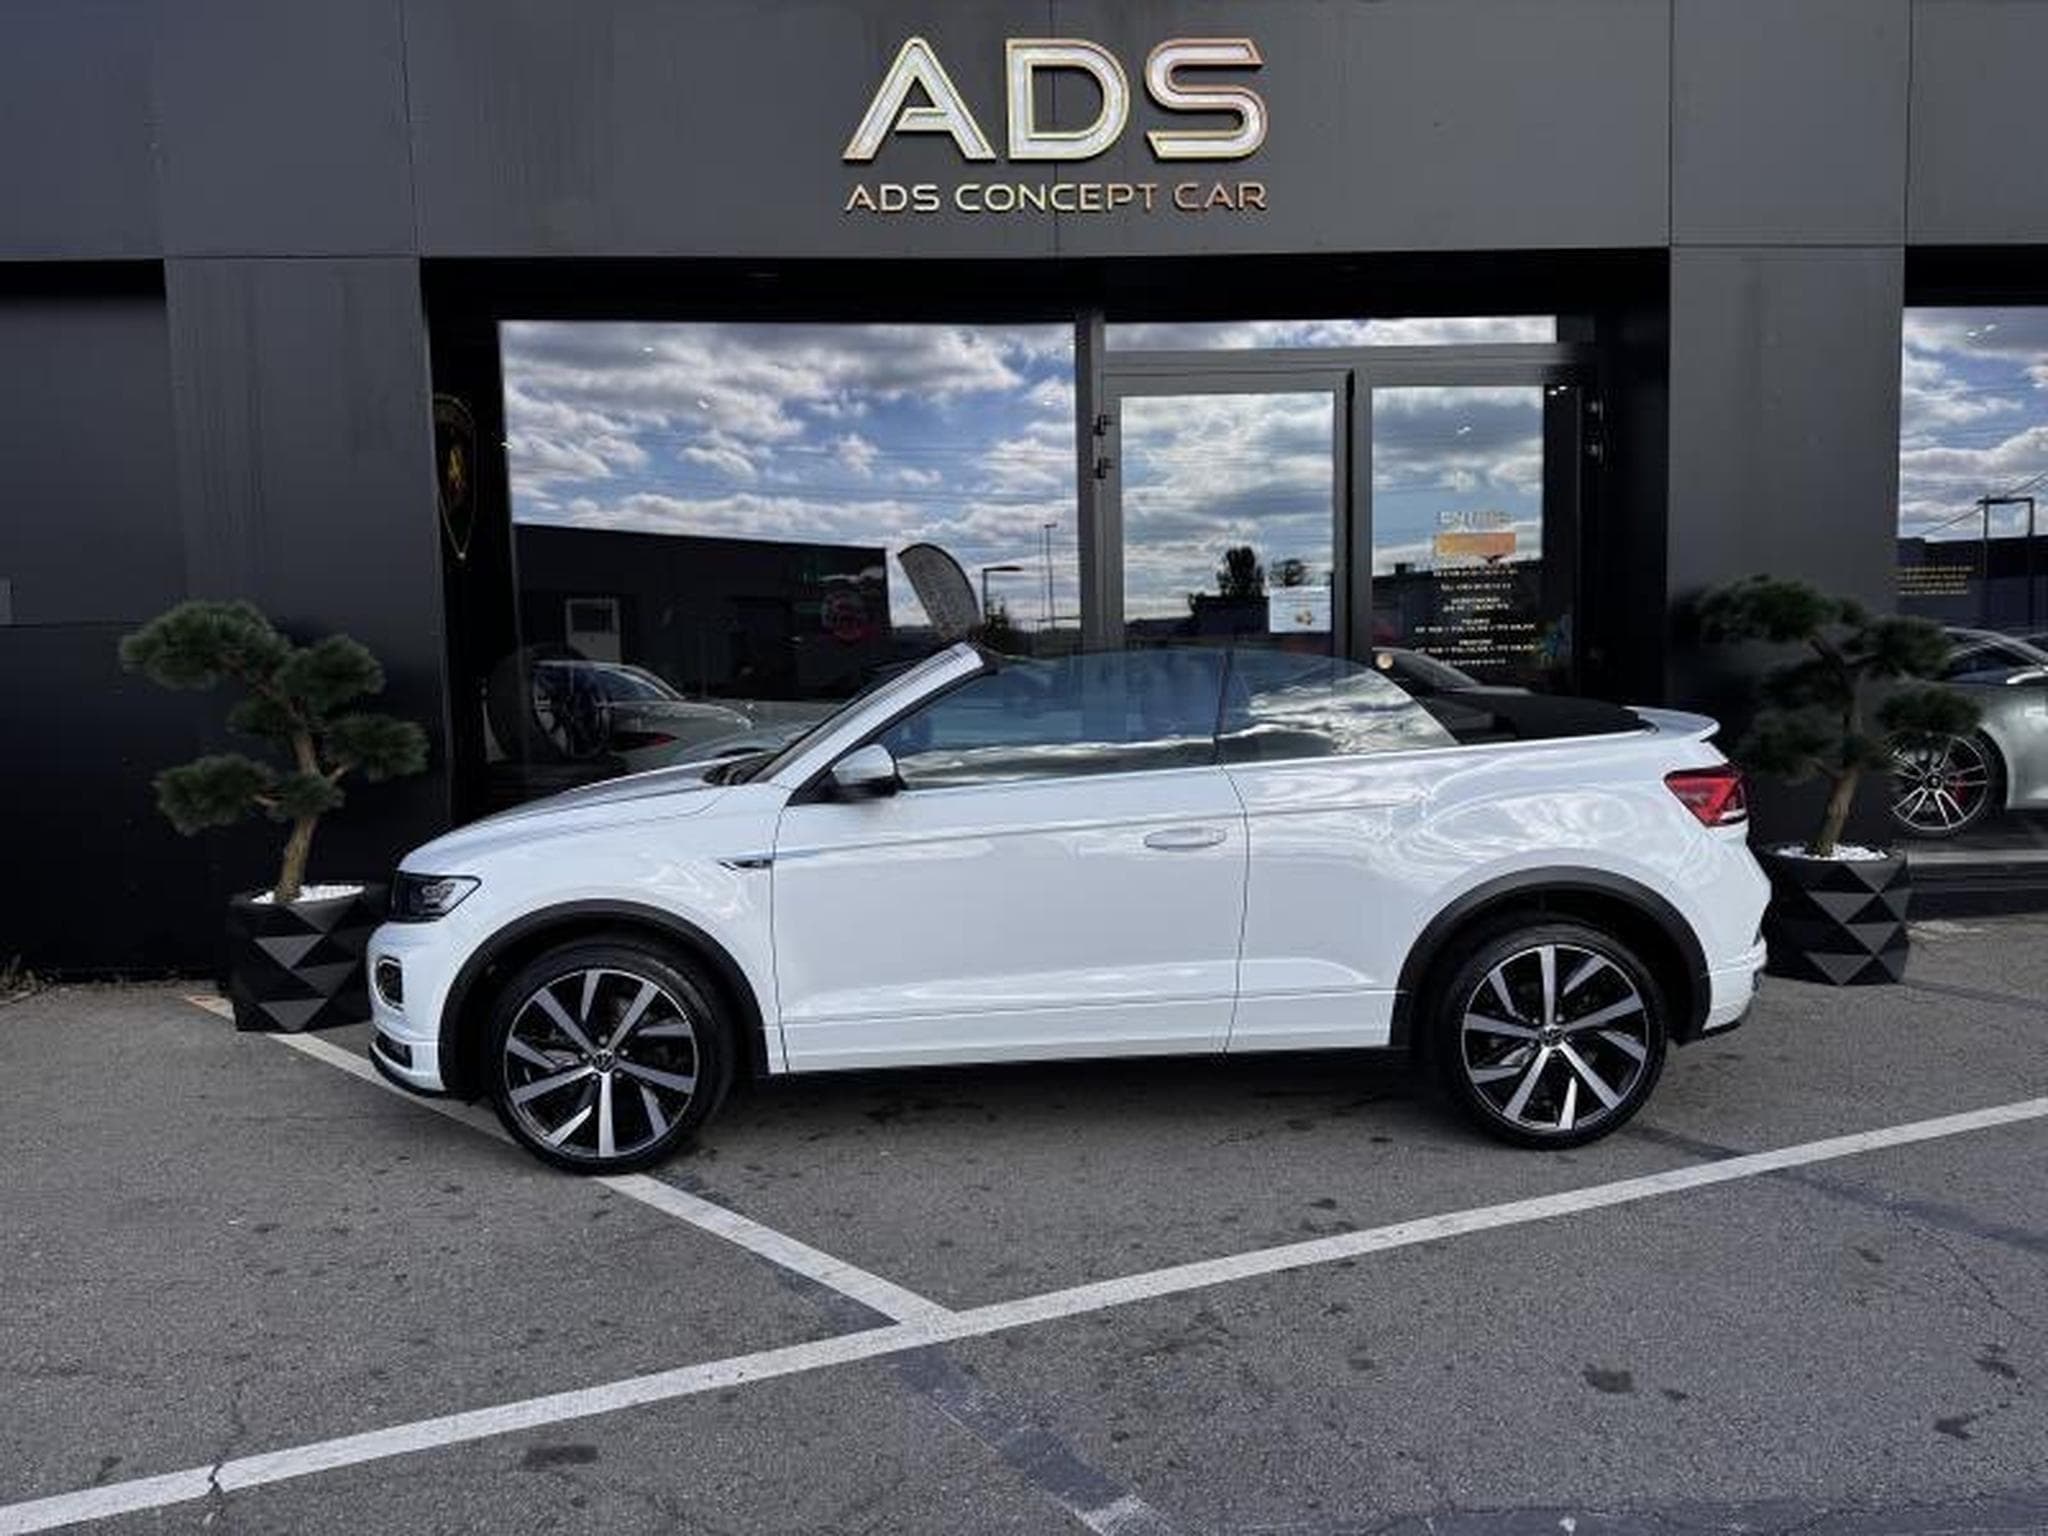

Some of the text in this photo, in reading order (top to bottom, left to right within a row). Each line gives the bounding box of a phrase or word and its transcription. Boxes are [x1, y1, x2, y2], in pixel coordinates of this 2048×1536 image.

[842, 36, 1268, 161] ADS
[844, 182, 1268, 212] ADS CONCEPT CAR
